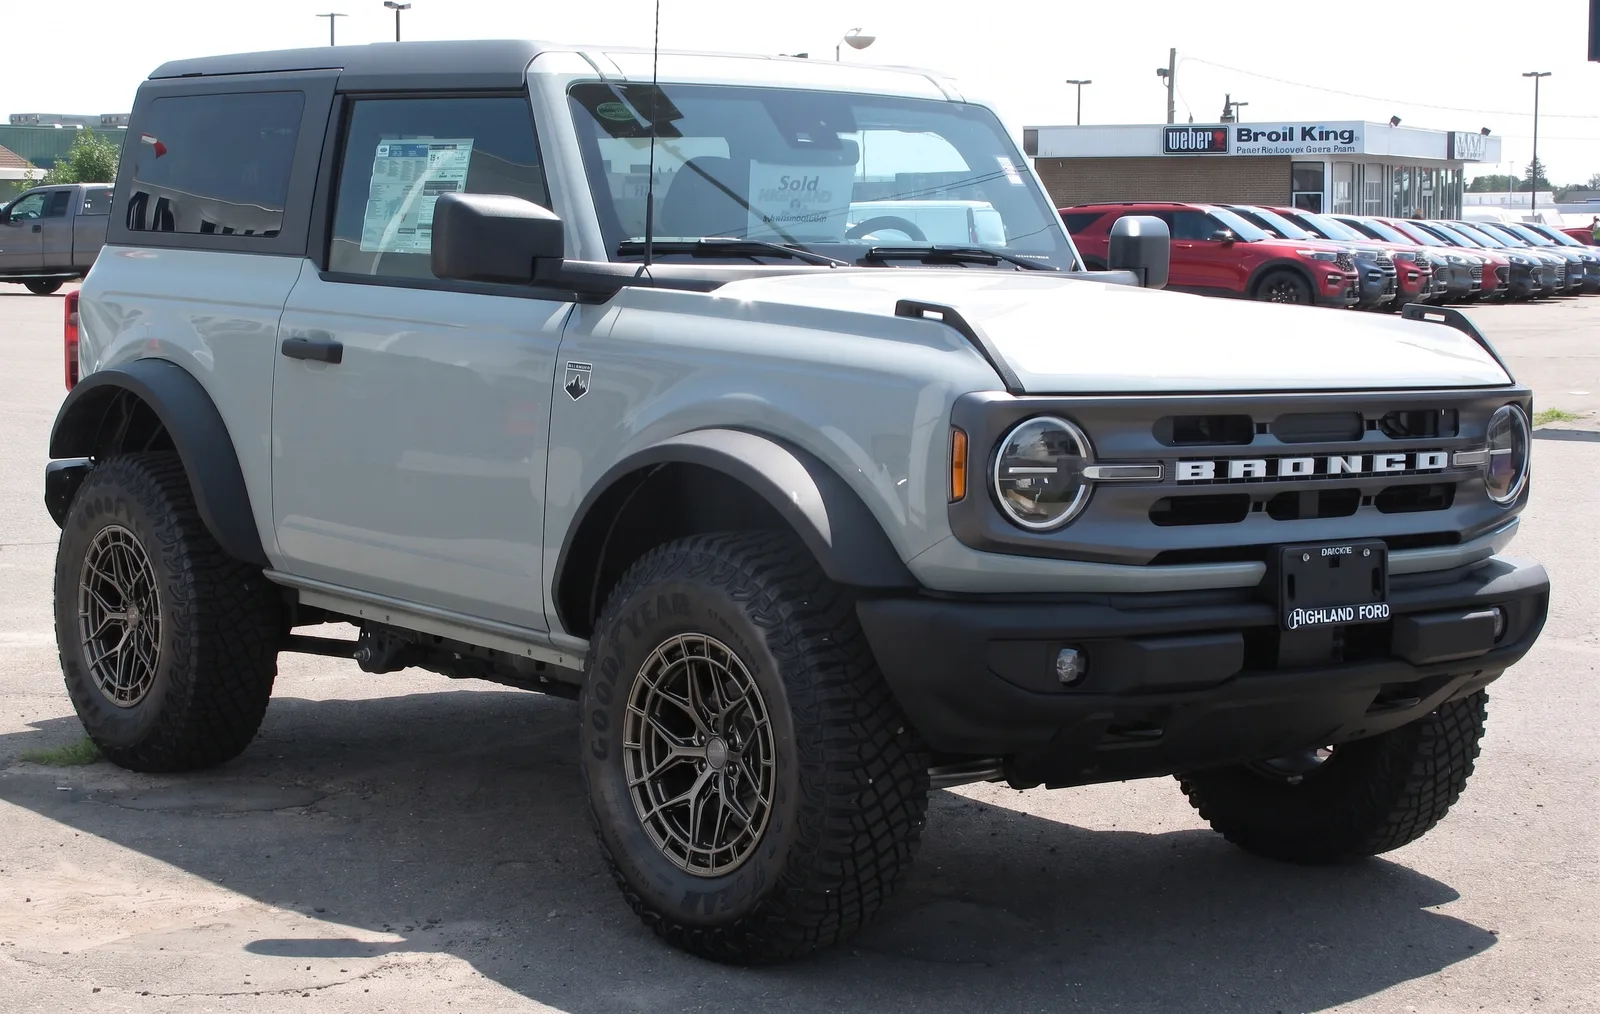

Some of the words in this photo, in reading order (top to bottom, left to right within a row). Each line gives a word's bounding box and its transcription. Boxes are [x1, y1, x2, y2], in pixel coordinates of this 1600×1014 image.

[1168, 128, 1212, 150] weber
[1236, 126, 1294, 143] Broil
[1301, 125, 1355, 145] King
[778, 175, 819, 192] Sold
[1175, 451, 1448, 480] BRONCO
[1288, 608, 1354, 630] HIGHLAND
[1359, 604, 1390, 620] FORD
